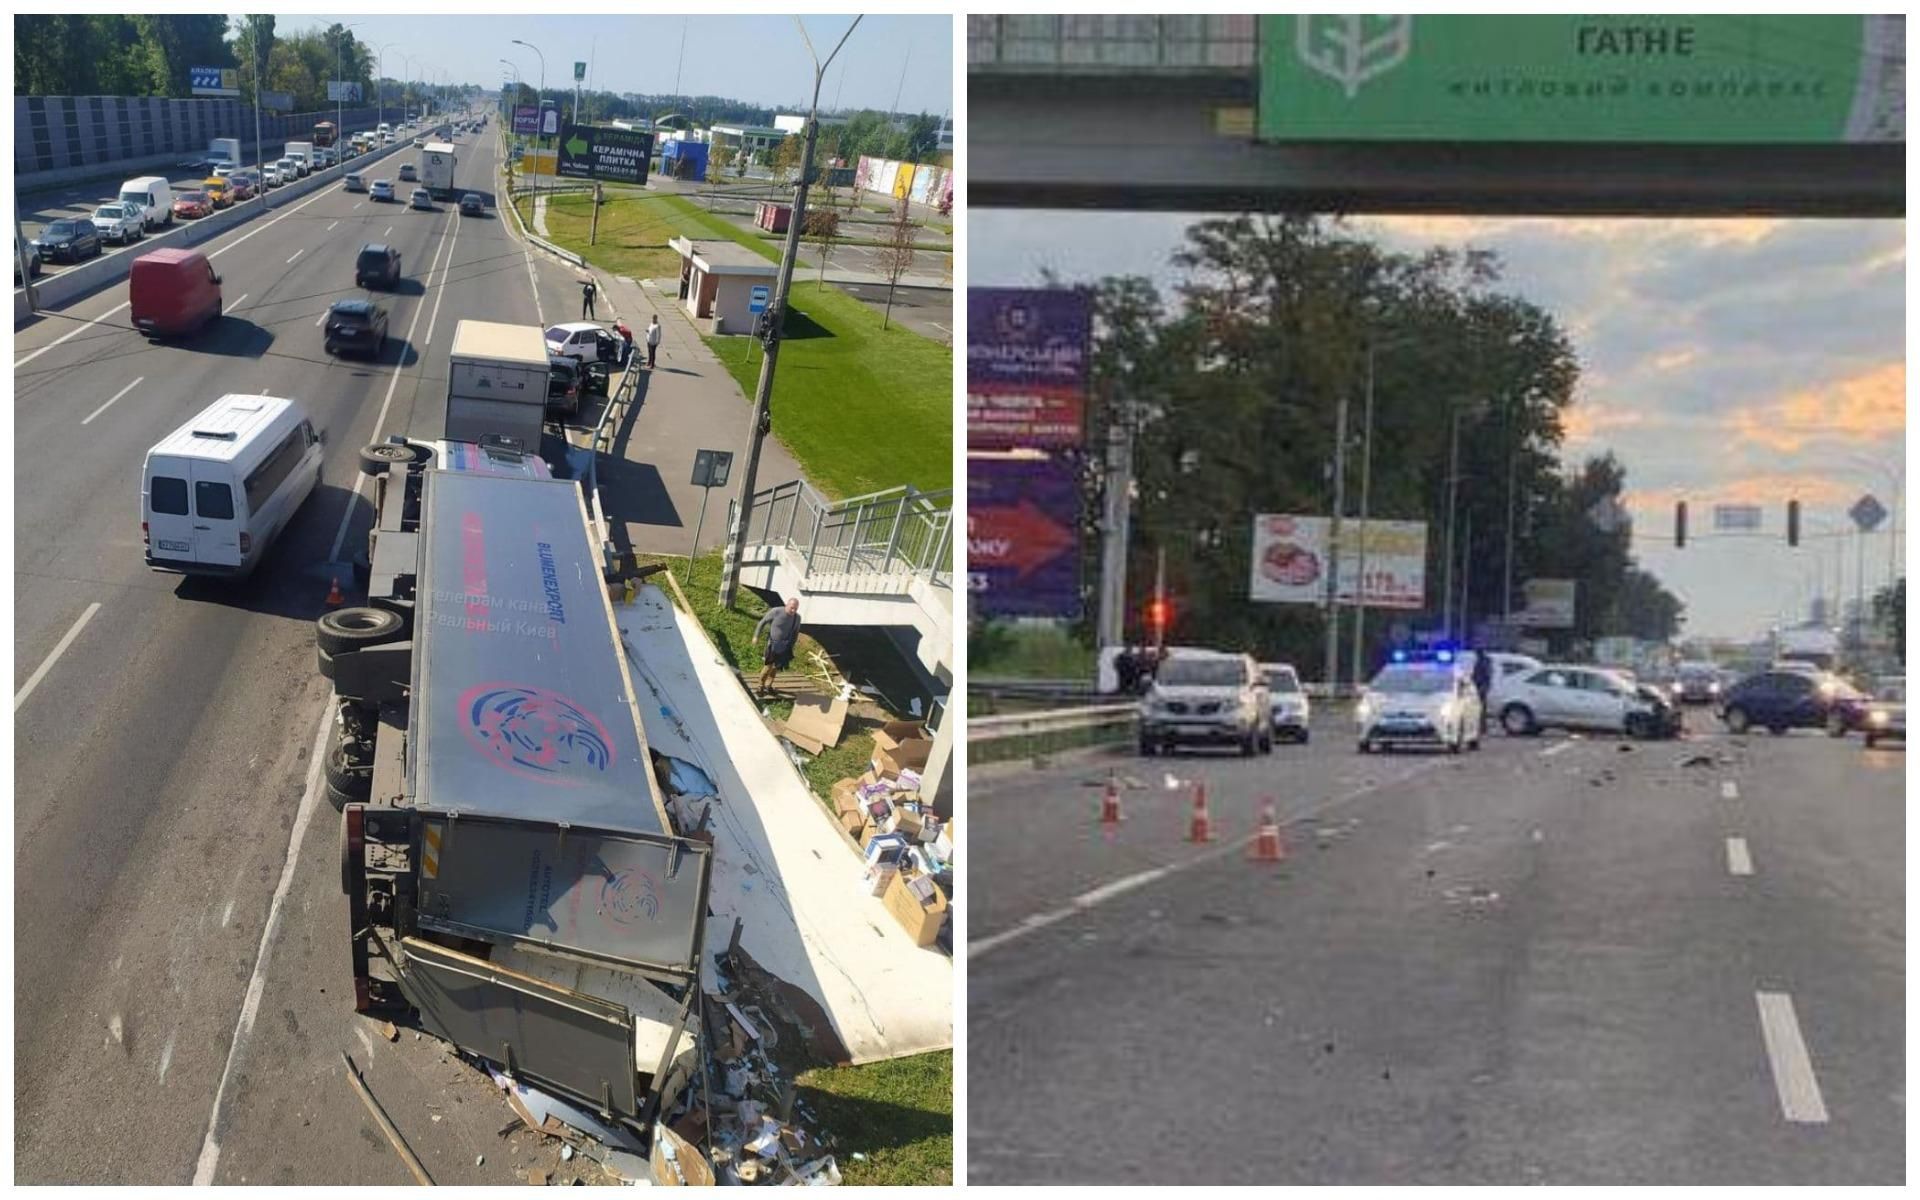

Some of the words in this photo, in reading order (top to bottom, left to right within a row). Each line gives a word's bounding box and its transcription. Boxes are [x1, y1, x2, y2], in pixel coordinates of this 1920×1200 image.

[1576, 26, 1696, 56] ГАТНЕ
[592, 145, 645, 159] КЕРАМІЧНА
[599, 155, 636, 166] ПЛИТКА
[537, 542, 566, 624] BLUMENEXPORT
